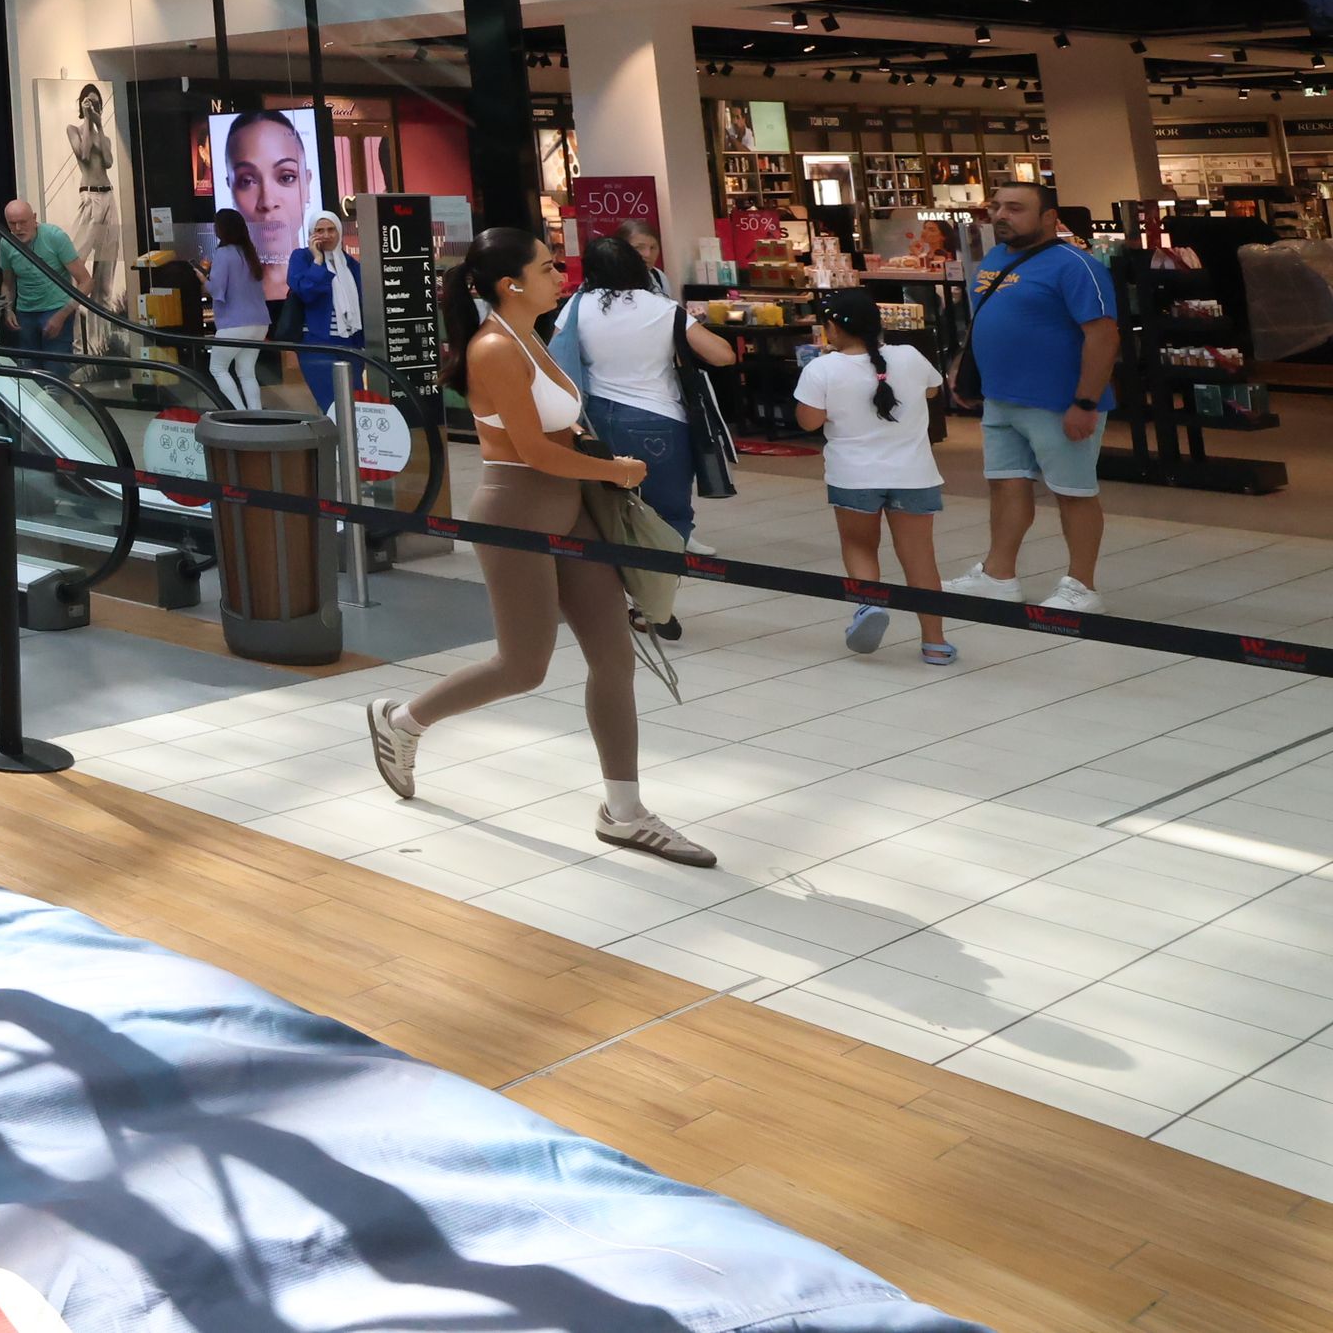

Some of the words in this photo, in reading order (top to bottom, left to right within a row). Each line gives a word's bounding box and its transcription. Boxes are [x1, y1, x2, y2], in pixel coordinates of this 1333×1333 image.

[1154, 128, 1179, 136] DIOR
[389, 224, 401, 253] 0
[841, 578, 890, 600] Westfield
[1025, 604, 1081, 628] Westfield
[1239, 637, 1307, 664] Westfield
